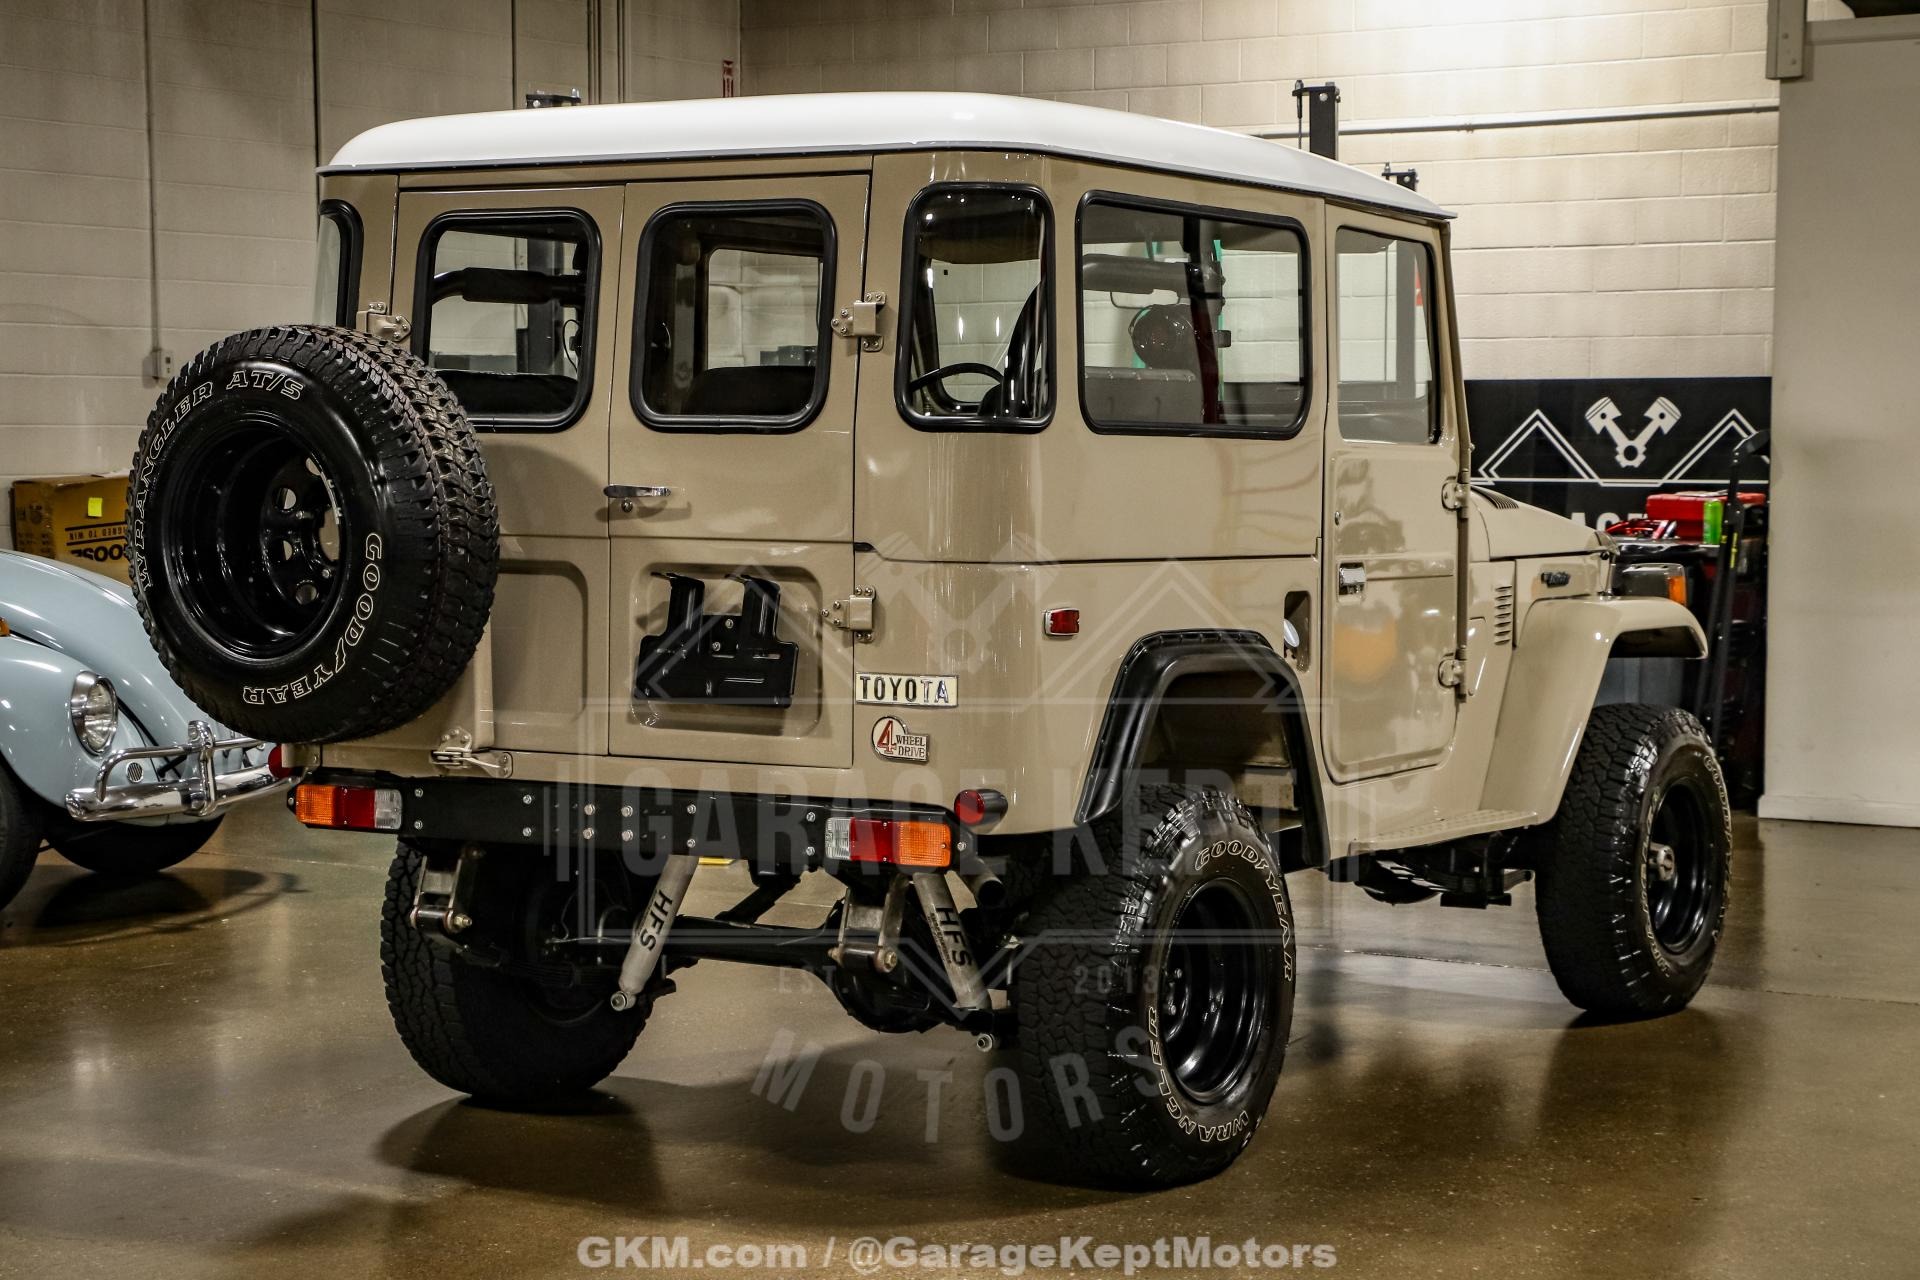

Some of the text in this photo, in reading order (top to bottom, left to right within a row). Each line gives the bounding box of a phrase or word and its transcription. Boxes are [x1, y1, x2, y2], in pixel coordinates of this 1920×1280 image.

[132, 370, 304, 591] WRANGLER AT/S
[859, 676, 949, 704] TOYOTA
[877, 719, 897, 755] 4
[895, 734, 926, 747] WHEEL
[898, 746, 926, 759] DRIVE
[639, 889, 673, 952] HFS
[935, 907, 972, 967] HFS
[1195, 839, 1294, 983] GOODYEAR
[1148, 1004, 1249, 1142] WRANGLER
